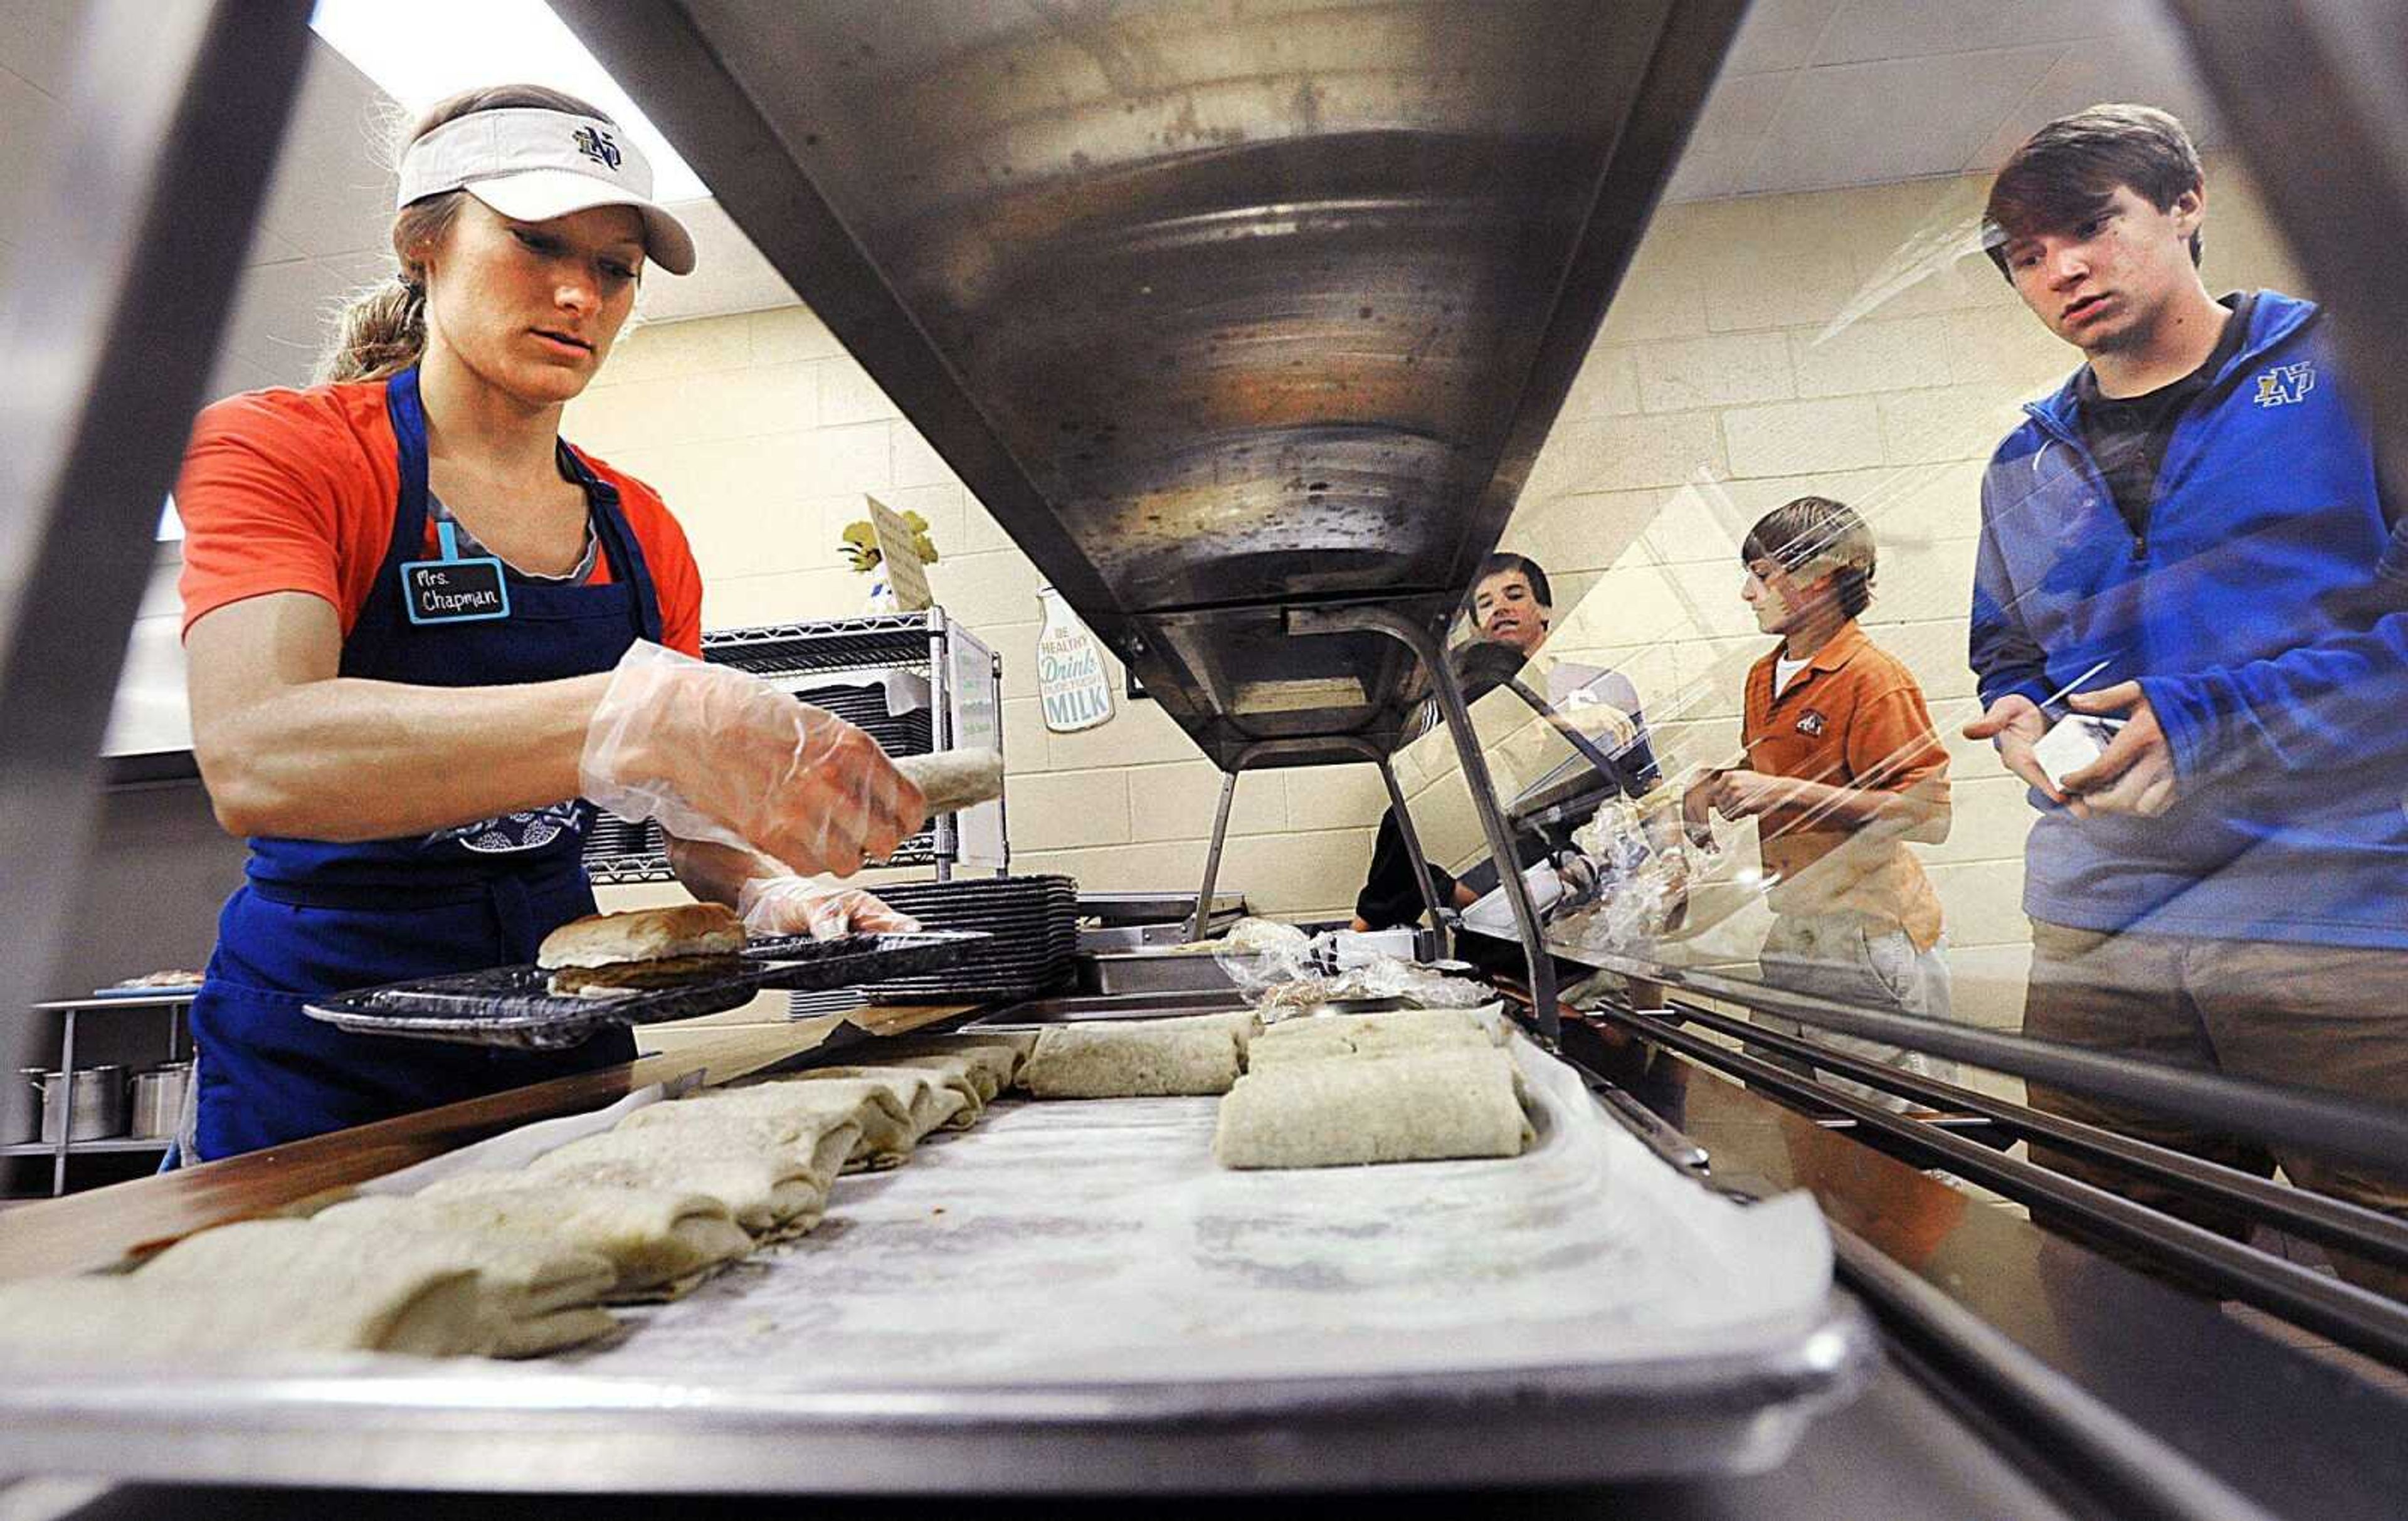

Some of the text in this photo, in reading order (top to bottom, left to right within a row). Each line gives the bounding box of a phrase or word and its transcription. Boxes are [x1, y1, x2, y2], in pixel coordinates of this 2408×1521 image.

[416, 569, 450, 587] Mrs.
[422, 589, 499, 612] Chapman
[1041, 636, 1087, 653] HEALTHY
[1041, 648, 1096, 683] Drink
